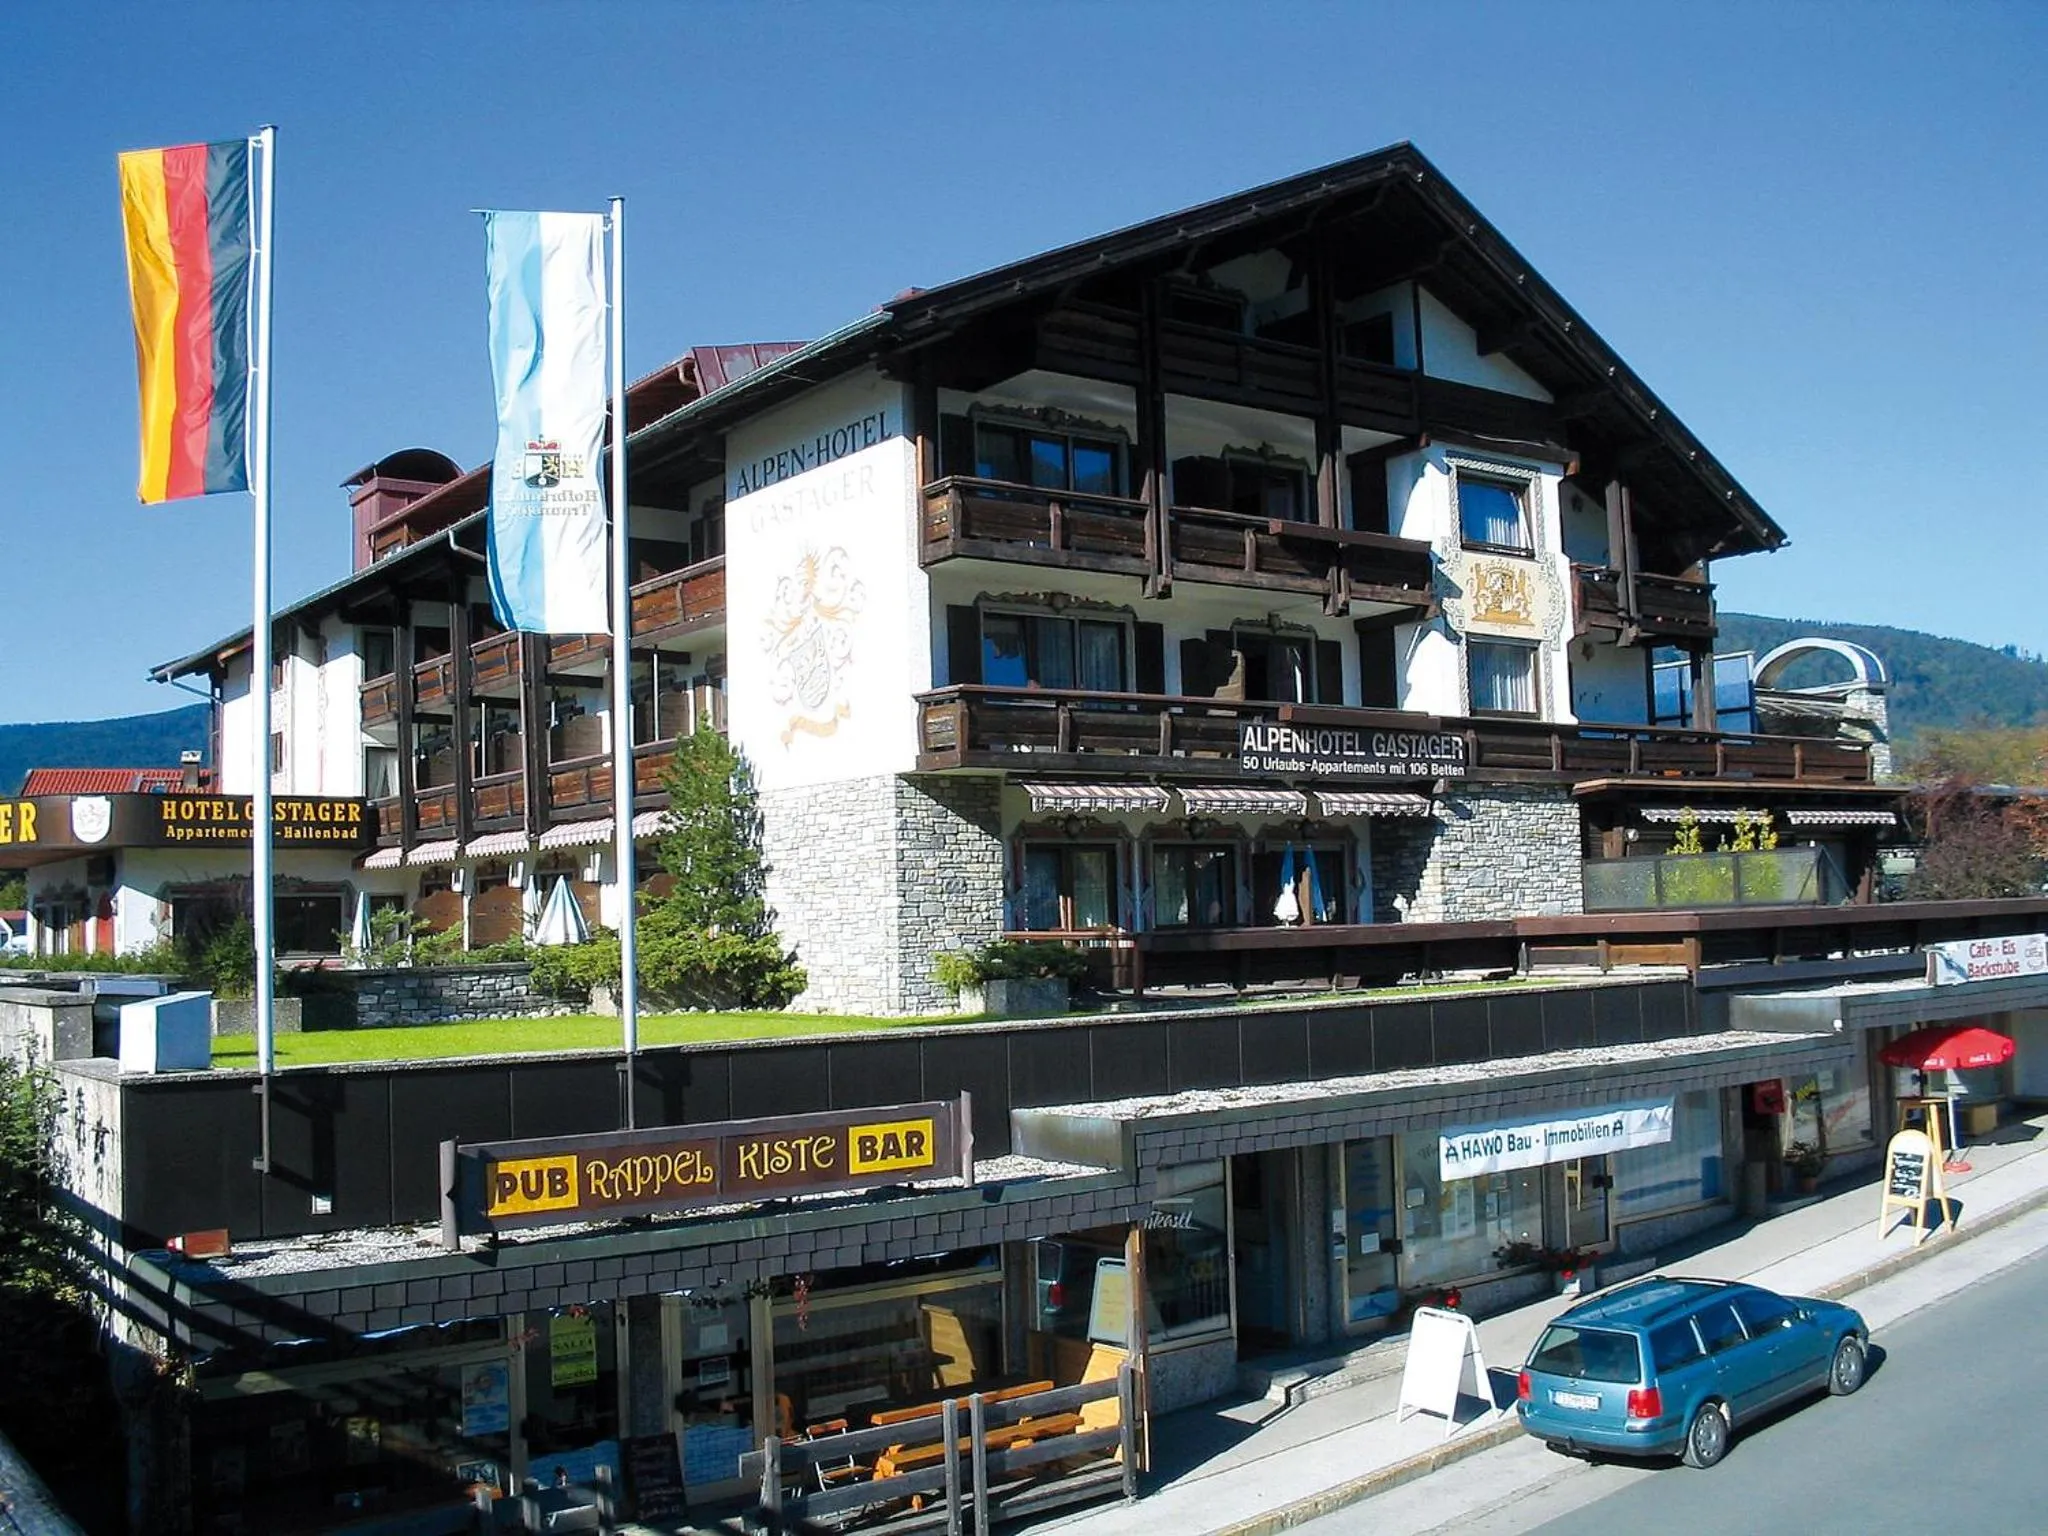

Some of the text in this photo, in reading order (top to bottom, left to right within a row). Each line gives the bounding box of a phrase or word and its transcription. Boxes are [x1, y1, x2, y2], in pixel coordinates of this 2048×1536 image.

[736, 411, 892, 497] ALPEN-HOTEL
[1243, 725, 1464, 760] ALPENHOTEL GASTAGER
[1243, 757, 1465, 777] 50 Urlaubs-Appartements mit 106 Betten
[162, 800, 361, 822] HOTEL GSTAGER
[1460, 1136, 1503, 1160] HAWO
[1507, 1133, 1532, 1152] Bau
[1543, 1123, 1611, 1146] Immobilien
[496, 1129, 926, 1204] PUB RAPPEL KISTE BAR
